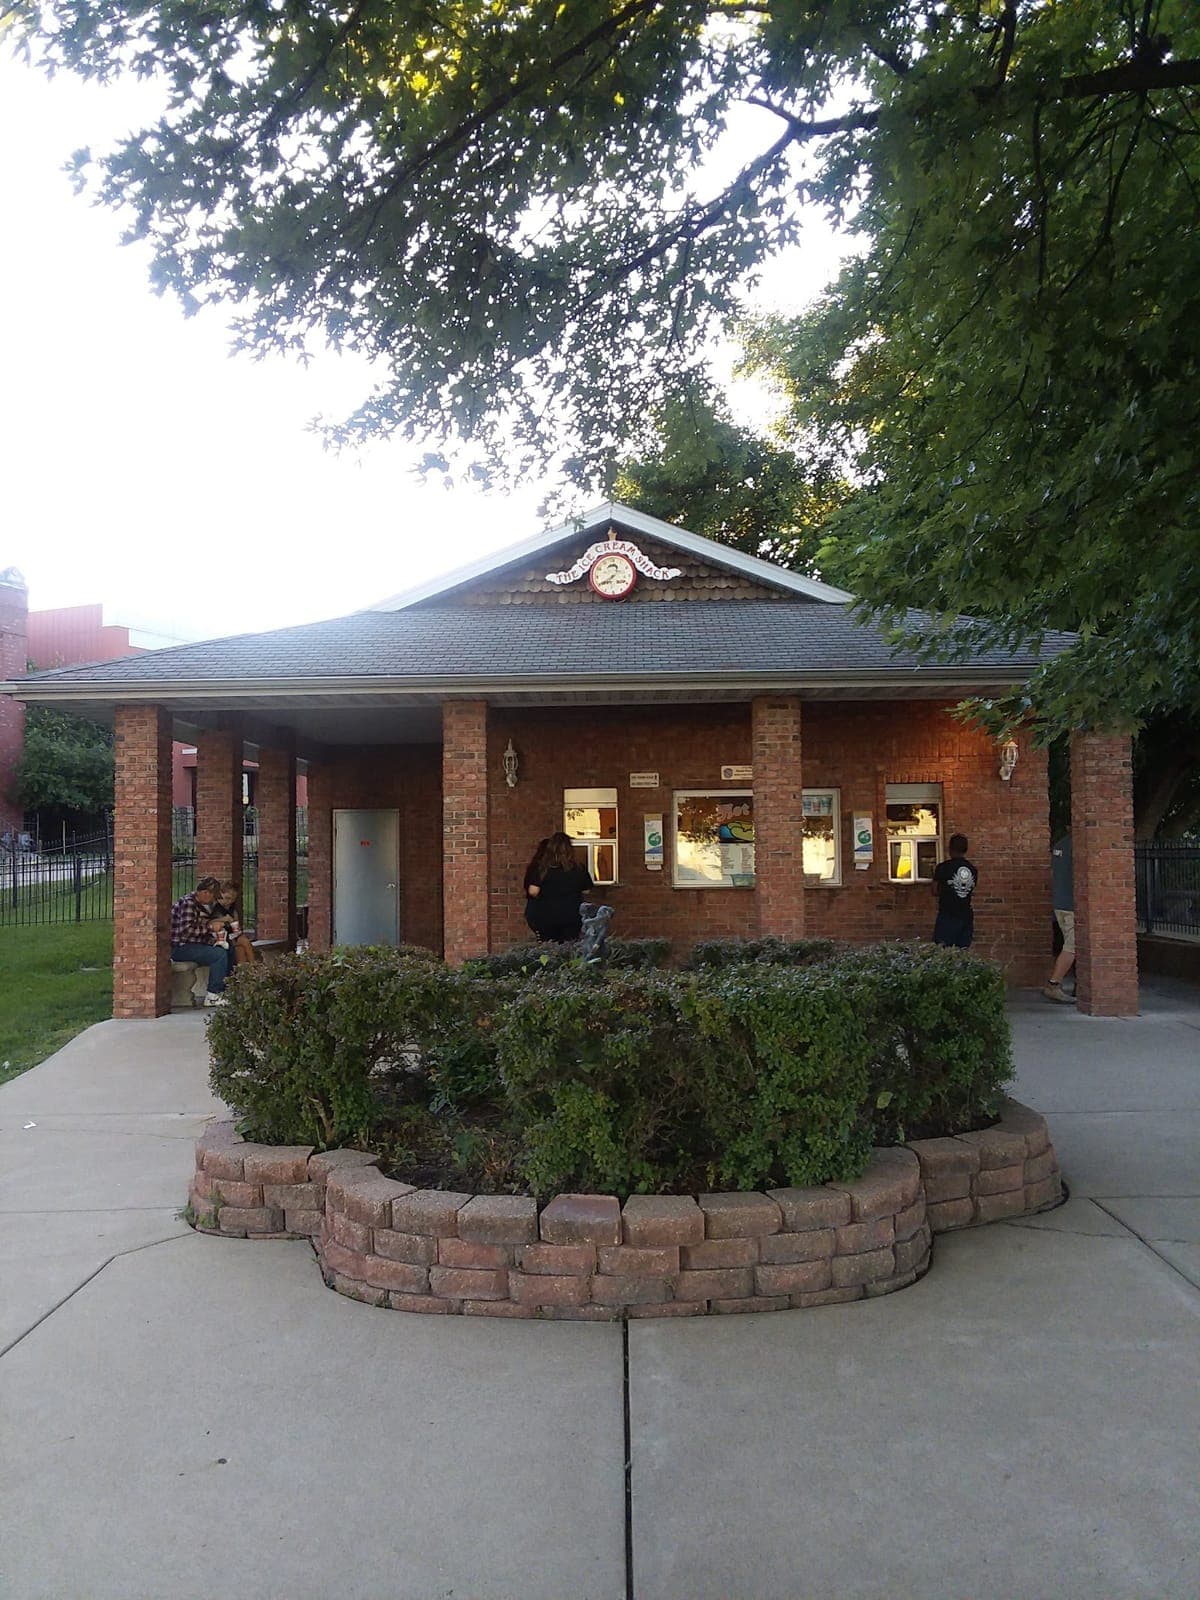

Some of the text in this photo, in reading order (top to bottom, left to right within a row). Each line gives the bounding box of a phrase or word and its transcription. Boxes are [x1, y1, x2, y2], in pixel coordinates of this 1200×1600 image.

[556, 542, 670, 583] THE ICE CREAM SHACK
